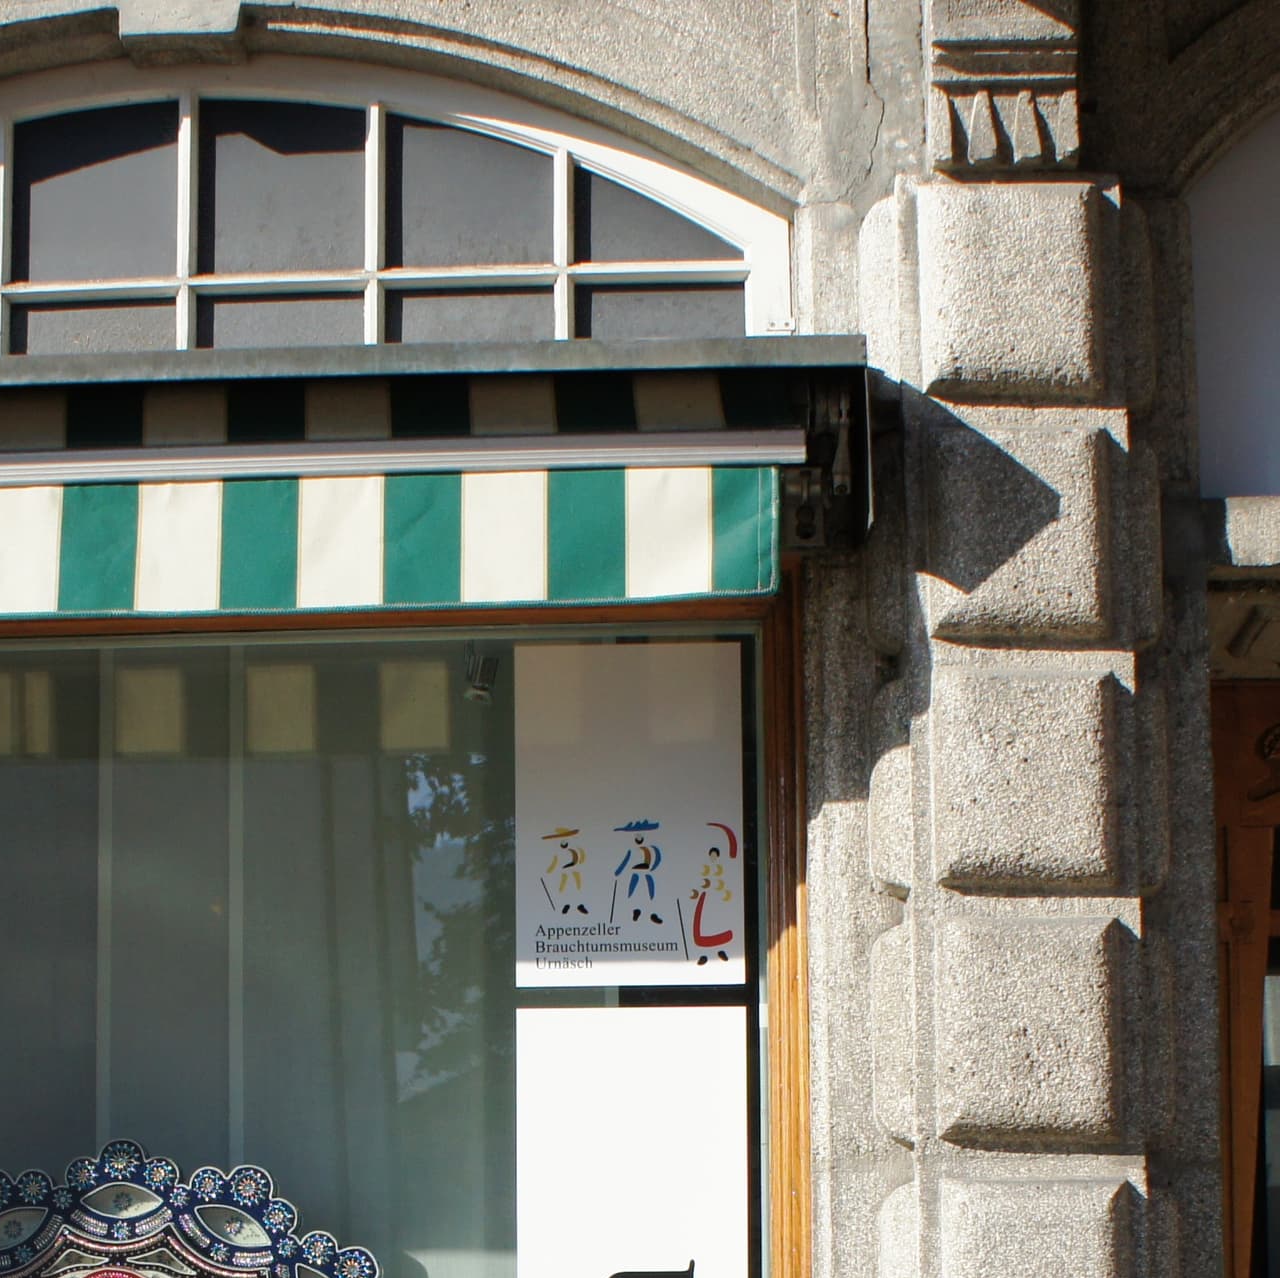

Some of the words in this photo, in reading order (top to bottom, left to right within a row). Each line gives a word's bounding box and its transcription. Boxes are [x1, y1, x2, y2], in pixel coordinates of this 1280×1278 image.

[536, 923, 622, 940] Appenzeller
[536, 940, 679, 954] Brauchtumsmuseum
[536, 957, 593, 969] Urnäsch
